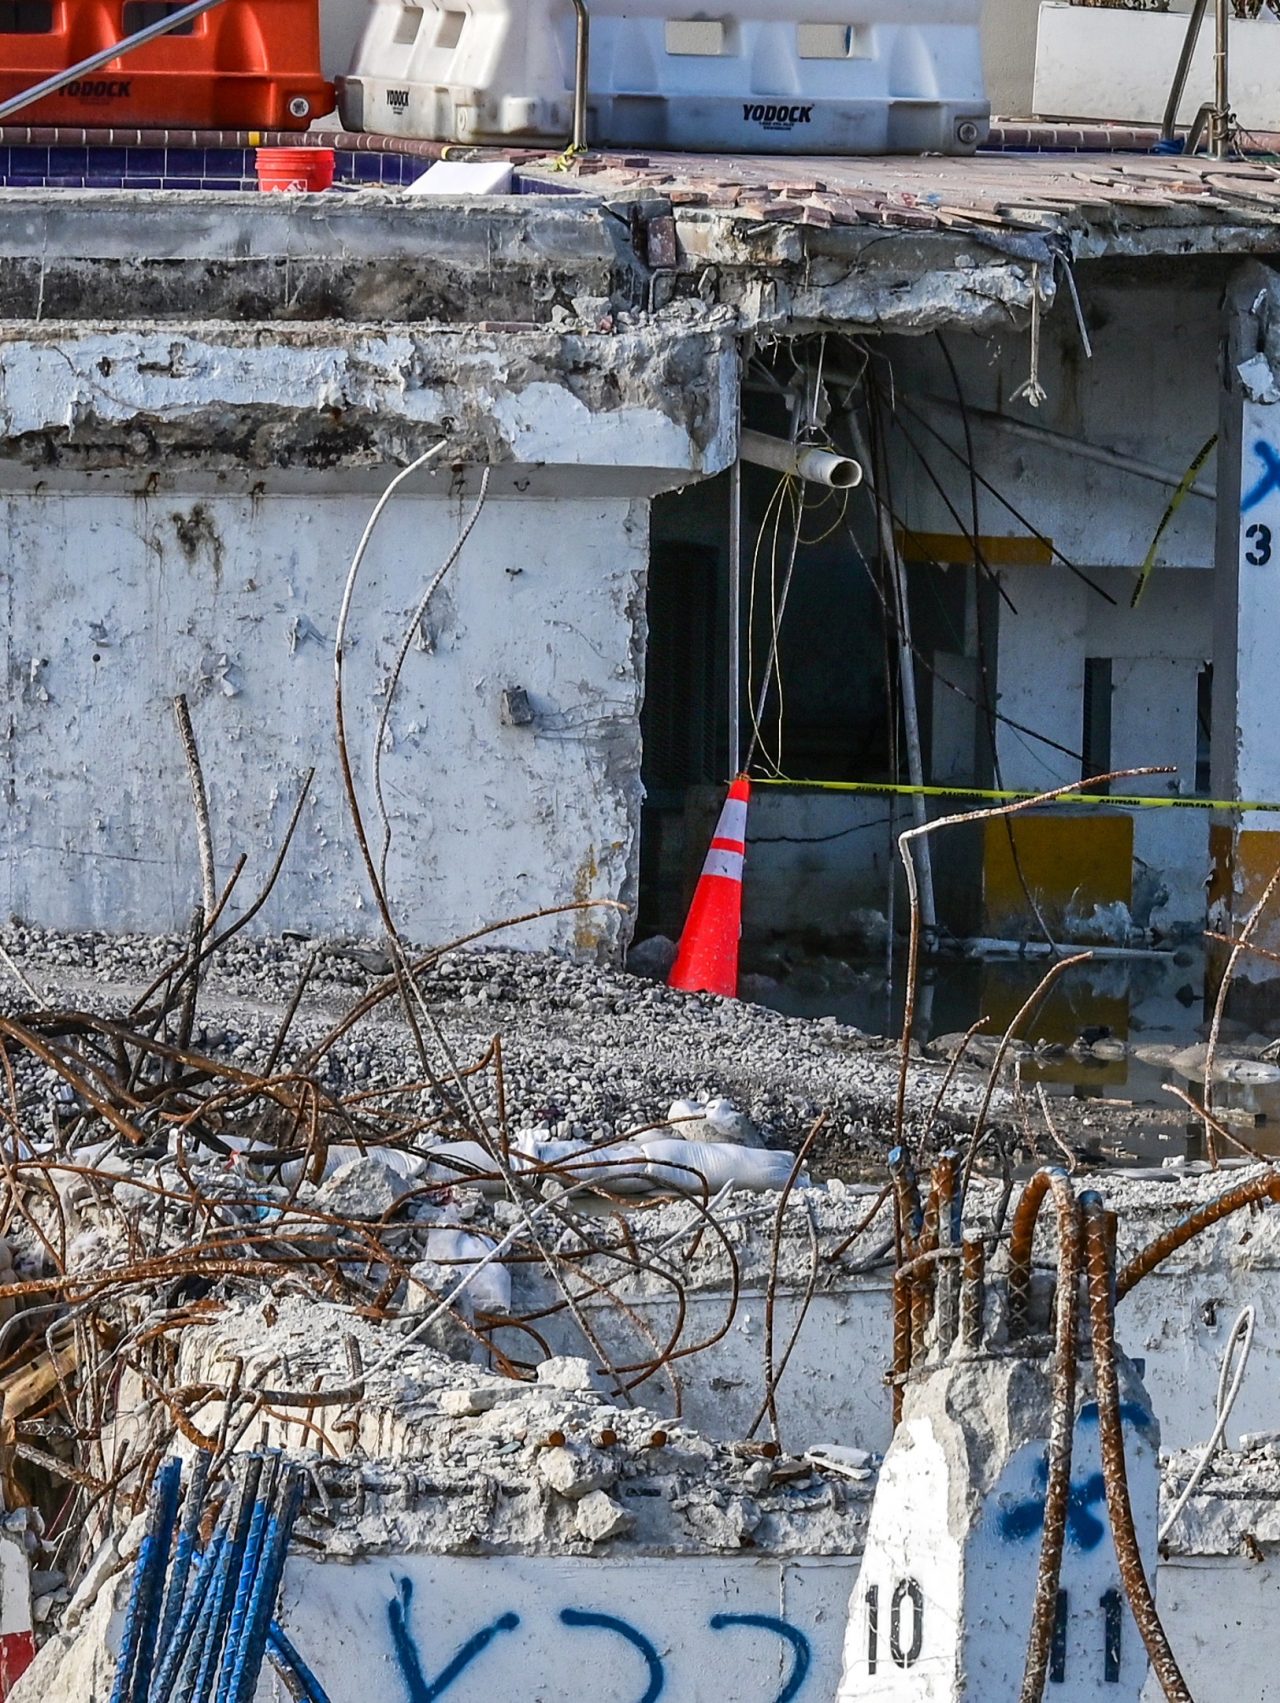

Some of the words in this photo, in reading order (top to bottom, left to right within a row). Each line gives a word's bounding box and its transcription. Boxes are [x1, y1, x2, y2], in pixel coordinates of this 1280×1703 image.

[386, 89, 410, 106] YODOCK
[743, 104, 813, 123] YODOCK
[865, 1576, 923, 1675] 10
